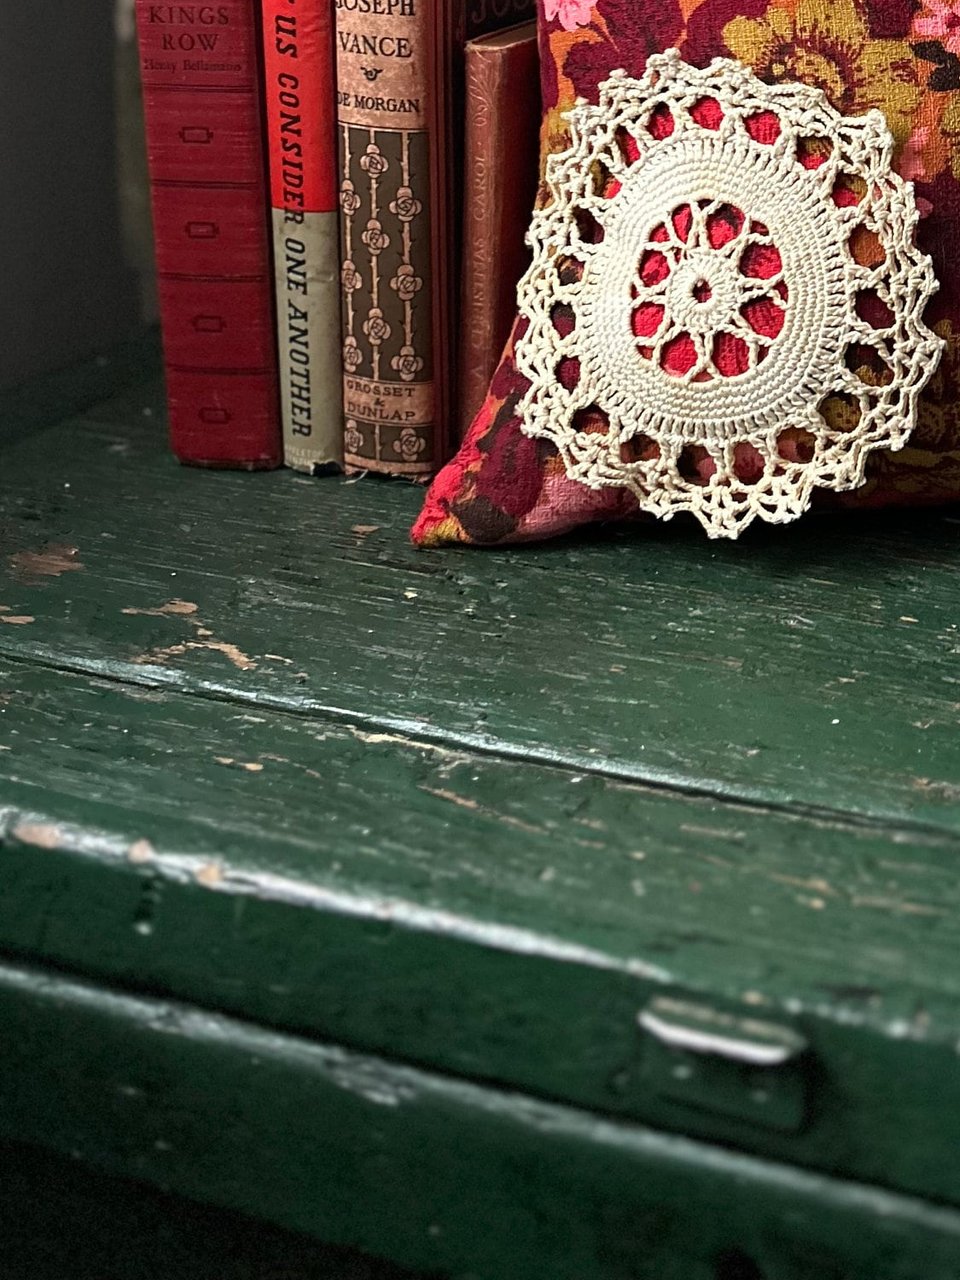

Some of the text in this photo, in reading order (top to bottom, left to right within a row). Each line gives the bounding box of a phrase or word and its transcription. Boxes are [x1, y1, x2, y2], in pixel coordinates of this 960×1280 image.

[148, 6, 229, 25] KINGS
[162, 33, 219, 51] ROW
[275, 14, 298, 59] US
[338, 31, 413, 58] VANCE
[337, 91, 420, 113] DE MORGAN
[277, 72, 305, 225] CONSIDER
[473, 150, 488, 221] CAROL
[285, 237, 307, 295] ONE
[288, 299, 312, 437] ANOTHER
[347, 380, 416, 397] GROSSET
[347, 402, 416, 421] DUNLAP
[374, 398, 385, 407] &
